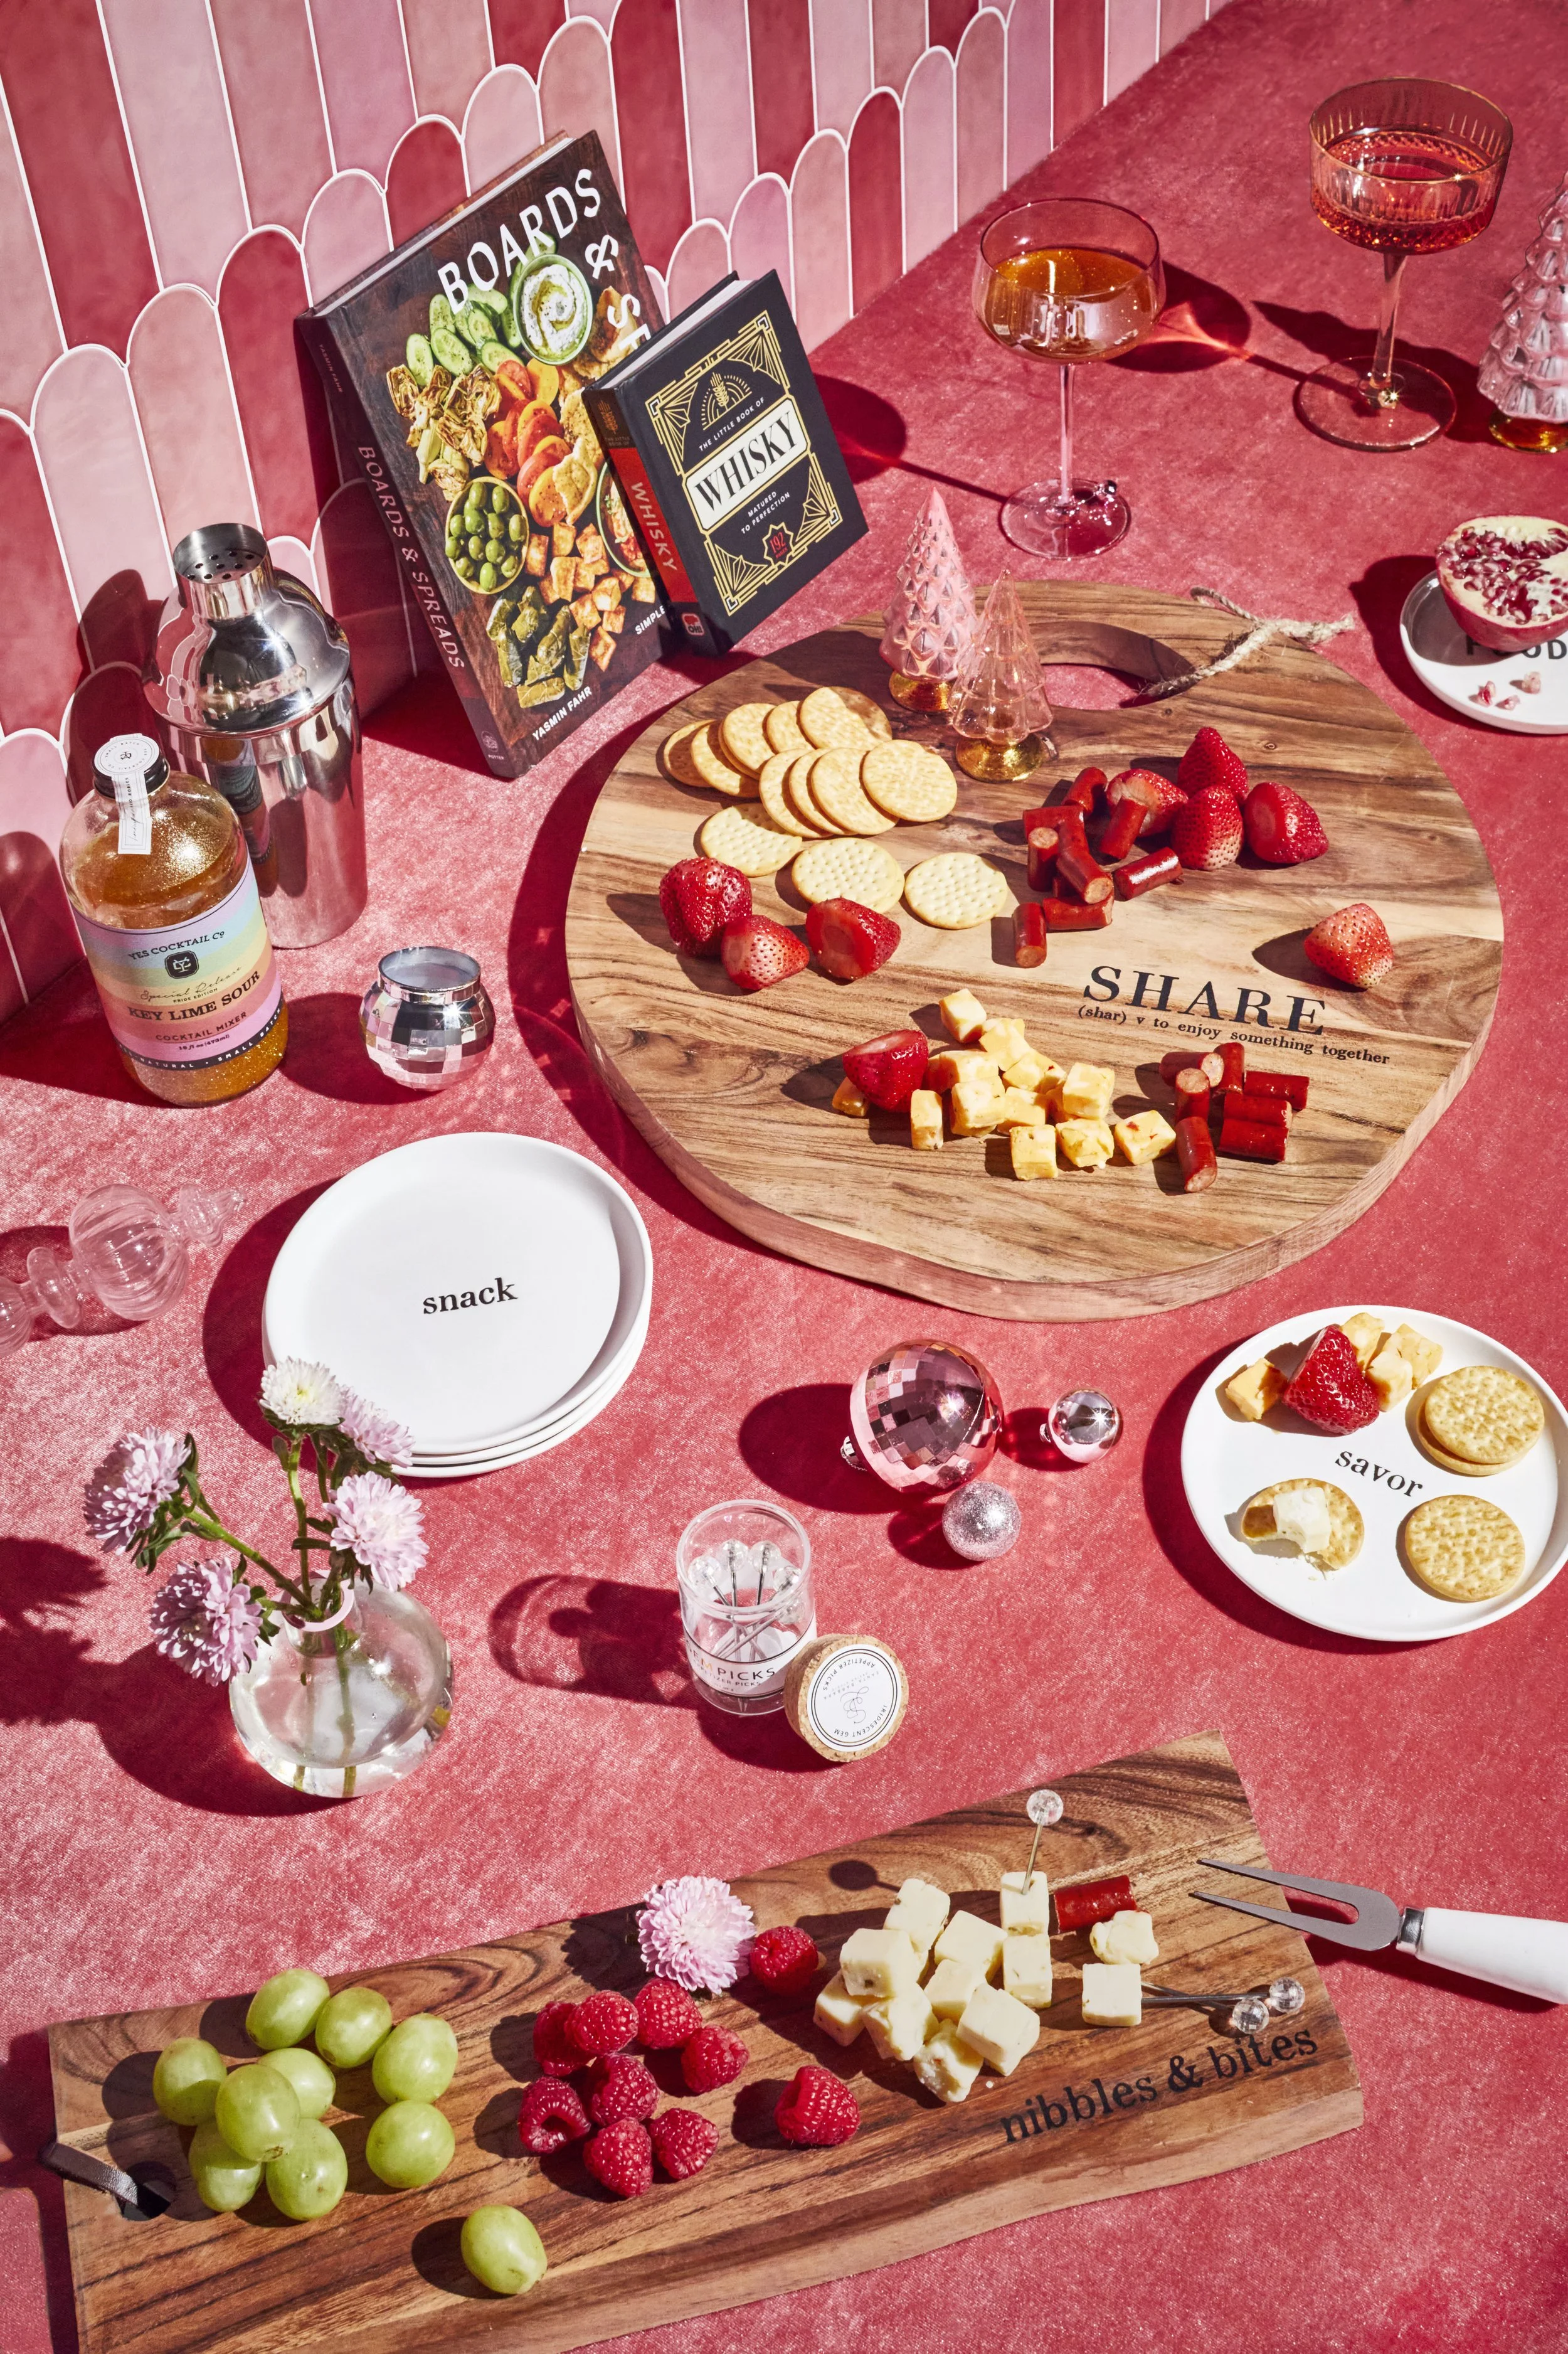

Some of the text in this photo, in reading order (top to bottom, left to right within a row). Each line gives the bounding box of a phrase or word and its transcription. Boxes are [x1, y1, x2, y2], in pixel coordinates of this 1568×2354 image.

[437, 169, 600, 314] BOARDS
[585, 235, 619, 279] &
[319, 344, 342, 392] YASMIN FAHR
[699, 397, 765, 452] THE LITTLE BOOK OF
[694, 411, 797, 511] WHISKY
[741, 492, 790, 534] TO PERFECTION
[748, 491, 777, 517] MATURED
[631, 482, 677, 572] WHISKY
[770, 531, 786, 553] 192
[358, 447, 464, 668] BOARDS & SPREADS
[635, 605, 665, 635] SIMPLE
[532, 686, 592, 740] YASMIN FAHR
[128, 950, 149, 960] YES
[151, 936, 210, 954] COCKTAIL
[128, 971, 260, 1021] KEY LIME SOUR
[140, 966, 241, 1002] Special Release
[194, 988, 218, 999] EDITION
[1083, 965, 1326, 1036] SHARE
[156, 1011, 247, 1041] COCKTAIL MIXER
[218, 1041, 253, 1062] SMALL
[260, 1008, 281, 1038] BATCH
[1078, 1004, 1391, 1065] (shar) v to enjoy something together
[423, 1277, 519, 1314] snack
[1335, 1451, 1423, 1497] savor
[717, 1667, 775, 1681] PICKS
[823, 1658, 876, 1691] APPETIZER PICKS
[834, 1705, 887, 1737] IRIDESCENT GEM
[1001, 2028, 1318, 2143] nibbles & bites
